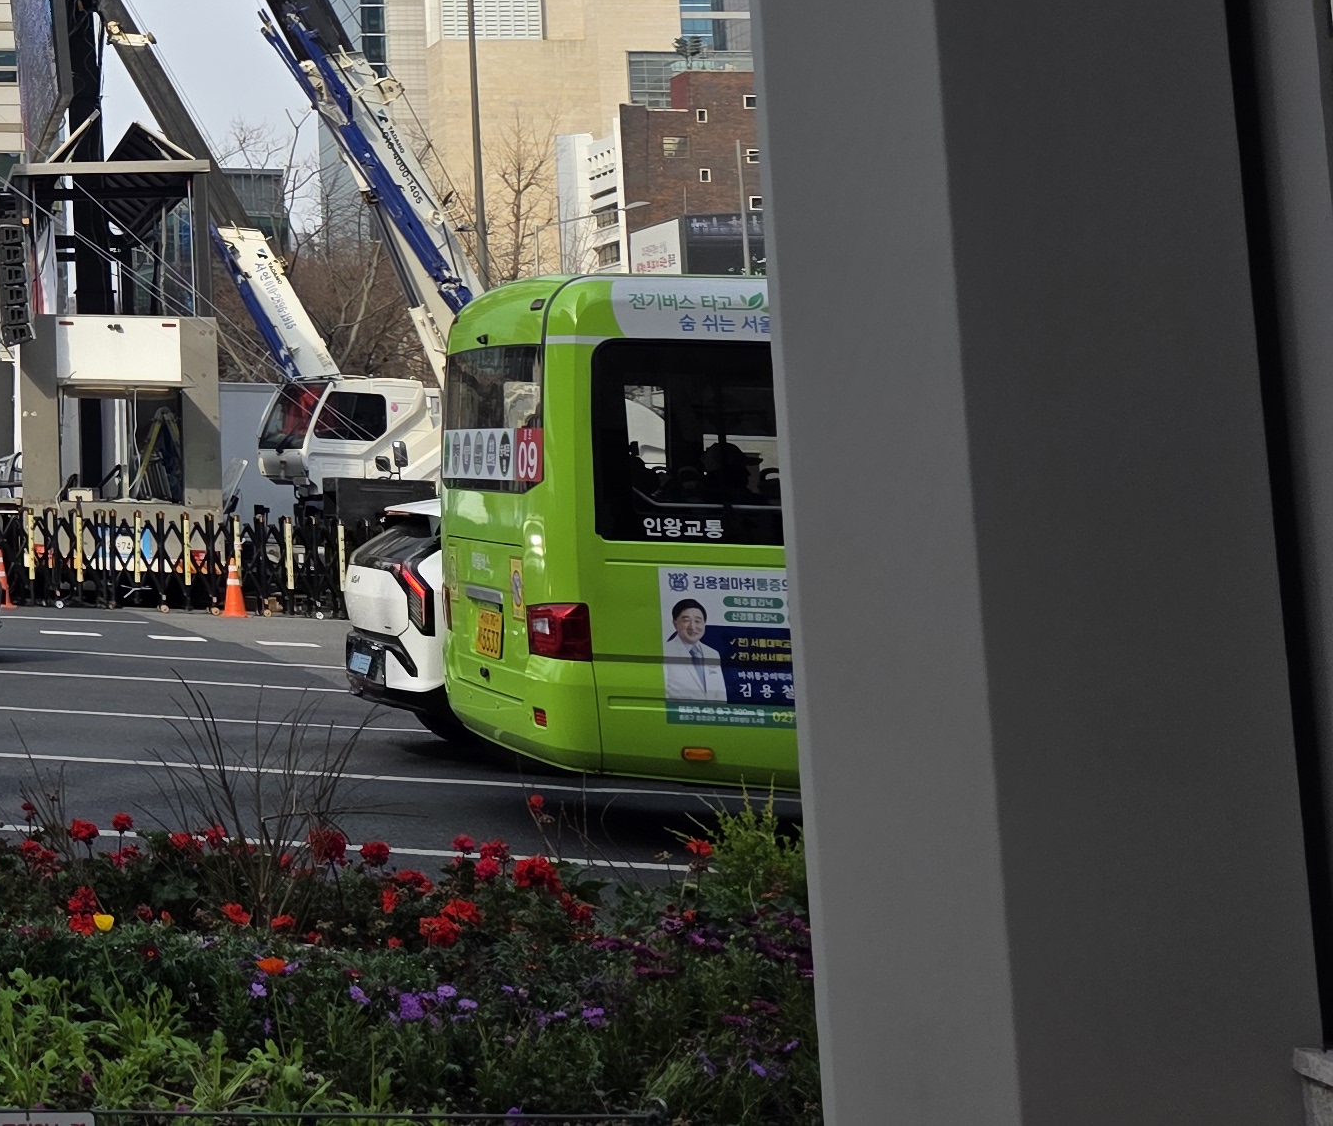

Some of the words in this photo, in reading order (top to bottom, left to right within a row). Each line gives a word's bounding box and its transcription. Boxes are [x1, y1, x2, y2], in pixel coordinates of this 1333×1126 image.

[387, 125, 405, 154] TADANO
[628, 293, 696, 311] 전기버스
[700, 294, 732, 312] 타고
[679, 314, 696, 332] 숨
[702, 314, 736, 333] 쉬는
[741, 315, 771, 333] 서울
[518, 441, 538, 479] 09
[643, 517, 724, 539] 인왕교통
